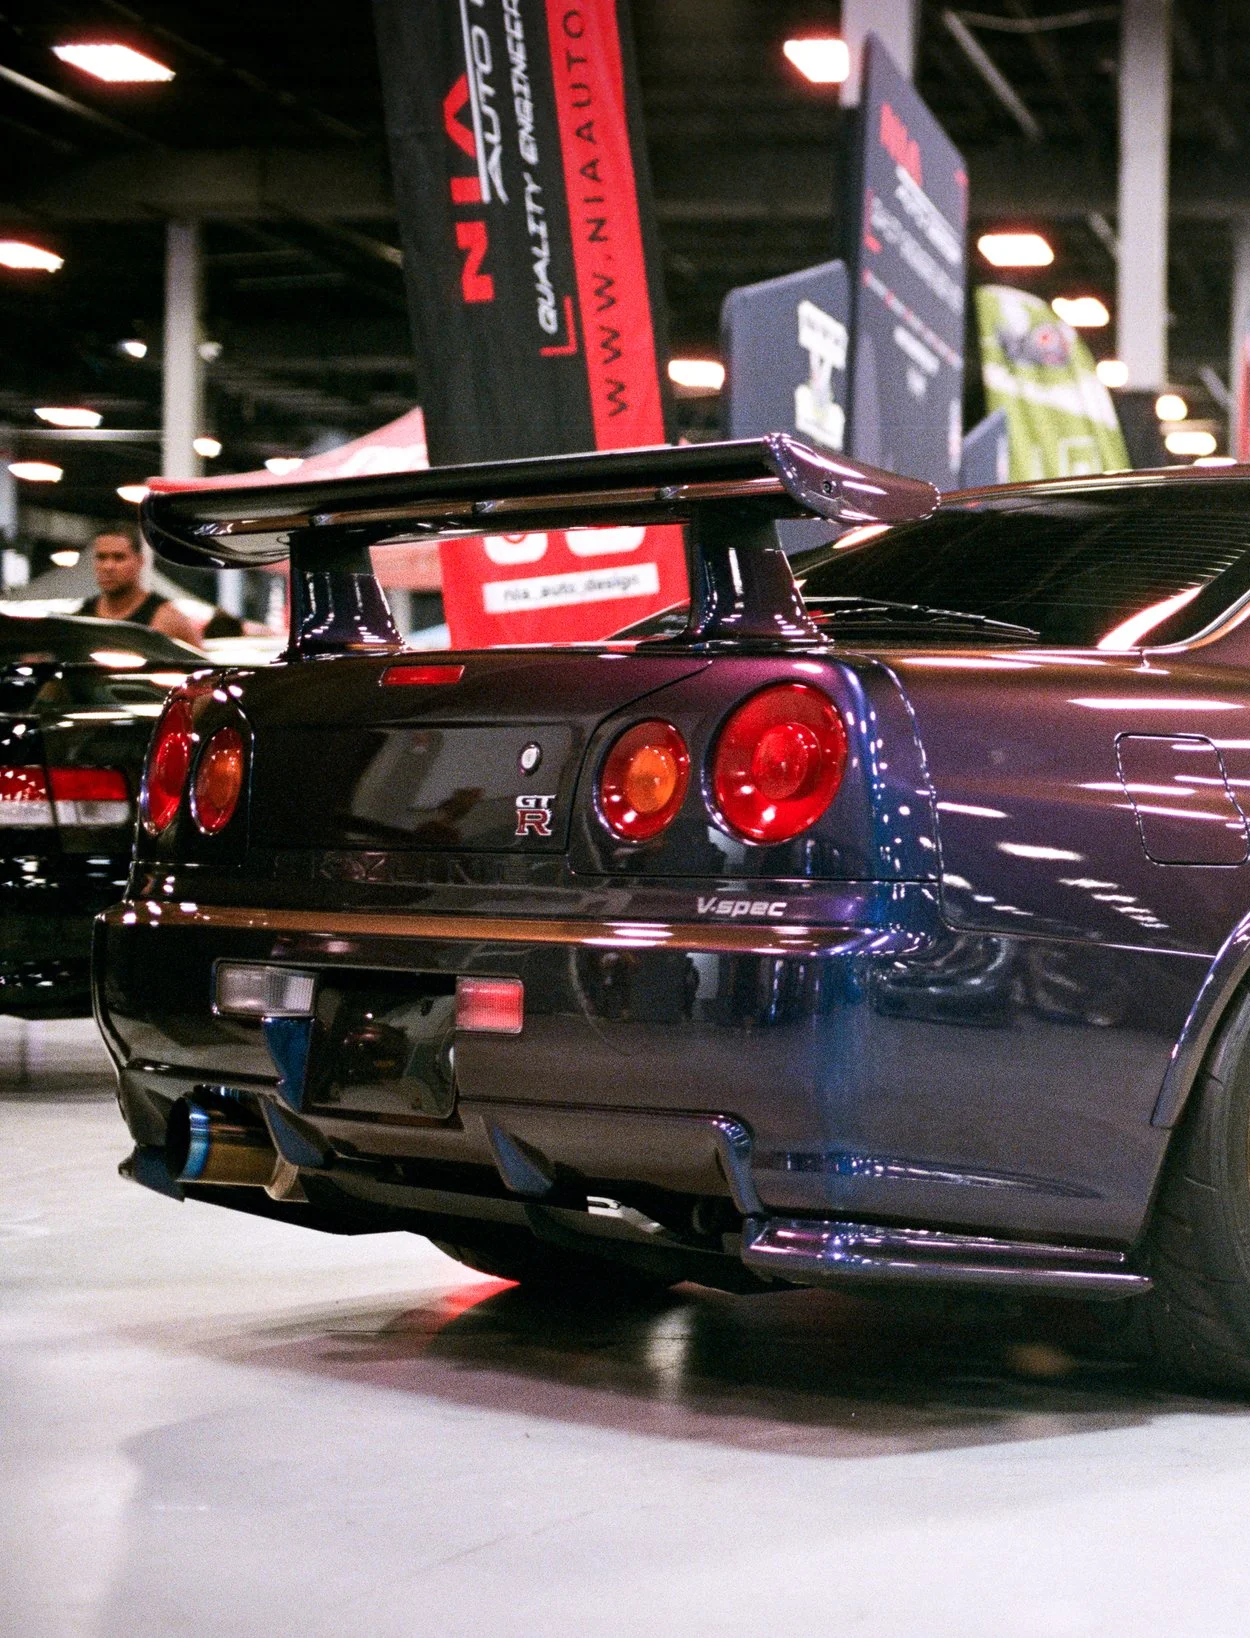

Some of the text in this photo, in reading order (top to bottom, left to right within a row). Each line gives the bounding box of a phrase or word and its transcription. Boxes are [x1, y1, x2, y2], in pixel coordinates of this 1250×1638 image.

[443, 72, 495, 303] NIA
[471, 25, 509, 204] AUTO
[523, 172, 558, 335] QUALITY
